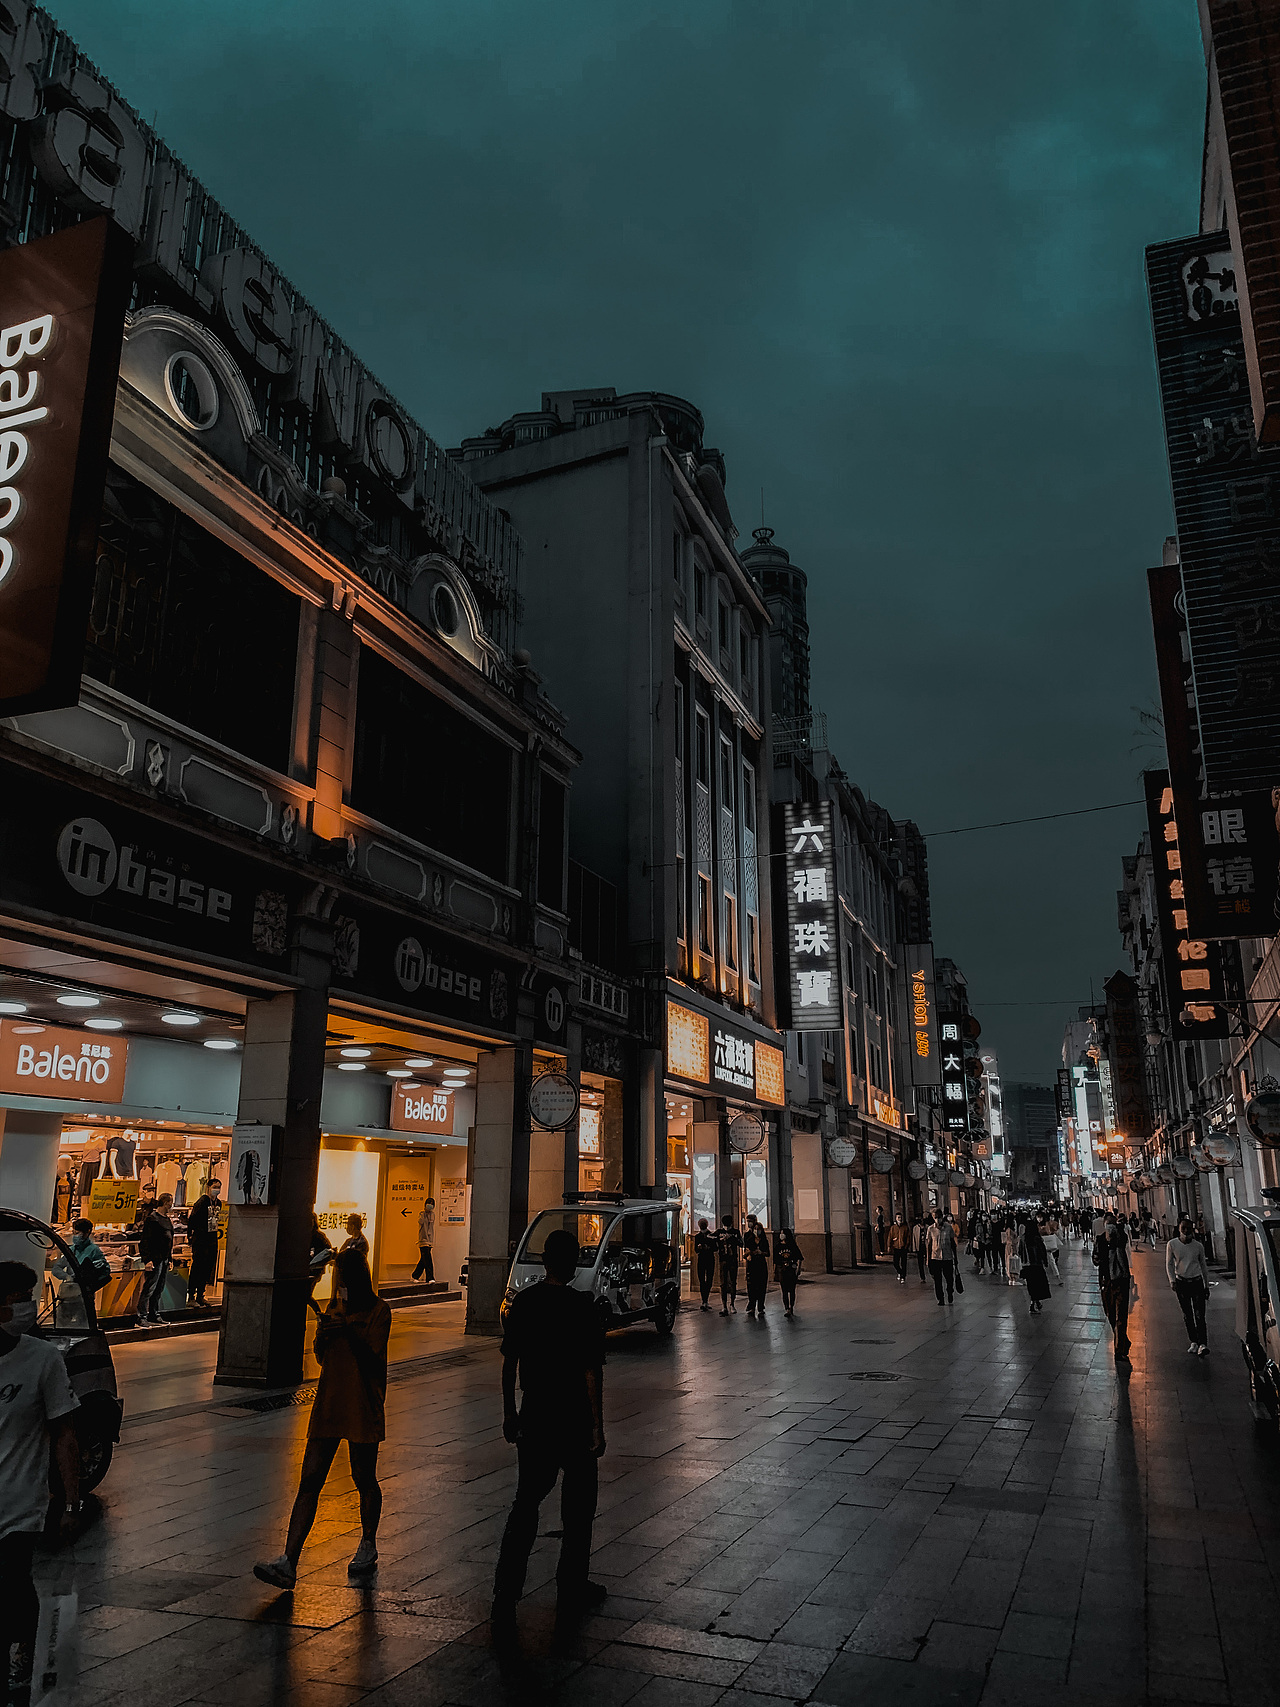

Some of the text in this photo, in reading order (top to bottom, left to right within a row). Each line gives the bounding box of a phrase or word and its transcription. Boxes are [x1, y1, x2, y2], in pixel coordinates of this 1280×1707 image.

[1202, 808, 1255, 895] 眼镜
[16, 1044, 110, 1084] Baleno
[942, 1024, 963, 1100] 周大福
[404, 1096, 447, 1123] Baleno
